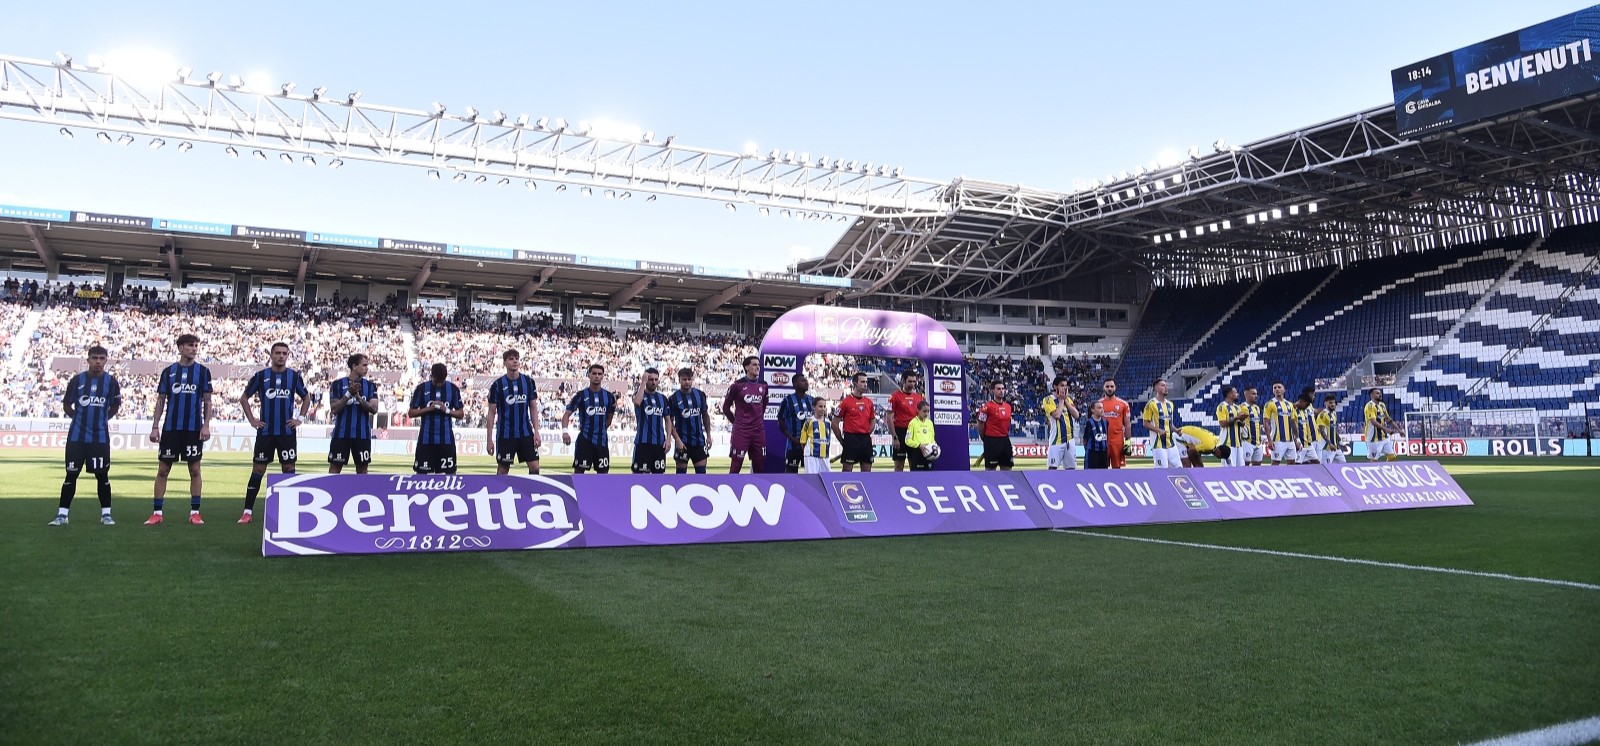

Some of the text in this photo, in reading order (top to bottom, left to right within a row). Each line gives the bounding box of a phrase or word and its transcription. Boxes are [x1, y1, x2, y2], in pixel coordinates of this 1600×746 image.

[1407, 66, 1432, 82] 18:14
[1465, 38, 1592, 95] BENVENUTI
[764, 356, 796, 367] NOW
[934, 364, 960, 376] NOW
[90, 396, 106, 404] TAO
[0, 433, 67, 448] eretta
[1397, 440, 1463, 455] Beretta
[1492, 439, 1562, 456] ROLLS
[186, 445, 198, 457] 33
[281, 448, 296, 461] 99
[359, 450, 369, 462] 10
[92, 457, 104, 469] 11
[440, 457, 454, 469] 25
[598, 457, 609, 468] 20
[654, 459, 665, 469] 66
[389, 475, 467, 492] Fratelli
[1341, 465, 1450, 490] CATTOLICA
[1203, 477, 1342, 503] EUROBET.live
[1362, 490, 1461, 505] ASSICURAZIONI
[899, 481, 1158, 515] SERIE C NOW
[272, 486, 574, 539] Beretta
[630, 483, 786, 530] NOW
[406, 534, 461, 550] 1812
